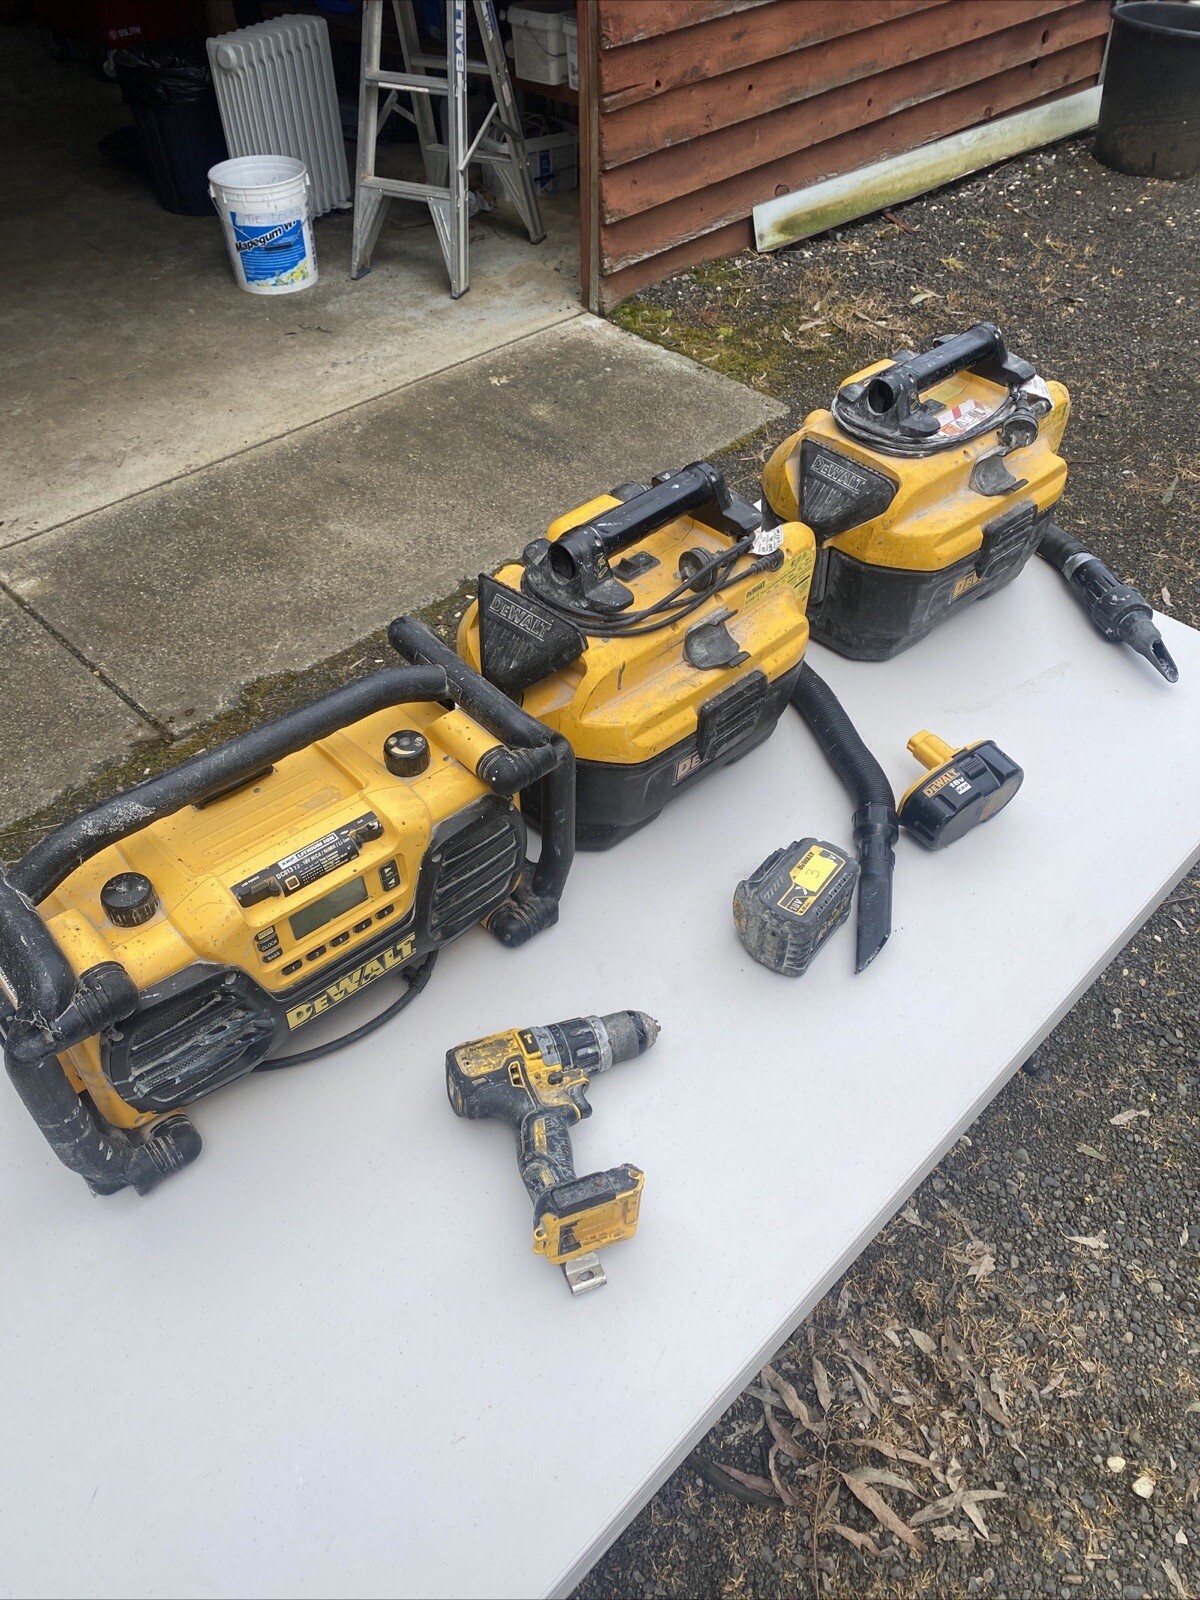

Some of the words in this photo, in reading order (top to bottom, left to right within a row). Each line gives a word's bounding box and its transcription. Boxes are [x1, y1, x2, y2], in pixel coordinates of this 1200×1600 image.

[235, 226, 282, 252] Mapegum
[811, 455, 867, 494] DEWALT
[489, 594, 552, 640] DEWALT
[923, 768, 960, 798] DEWALT
[949, 777, 964, 788] 18V
[296, 841, 323, 858] LITHIUM
[322, 834, 335, 844] ION
[804, 868, 821, 879] 3
[789, 897, 802, 912] 18V
[261, 939, 278, 951] CLOCK
[267, 950, 281, 961] BASS
[286, 935, 417, 1031] DEWALT
